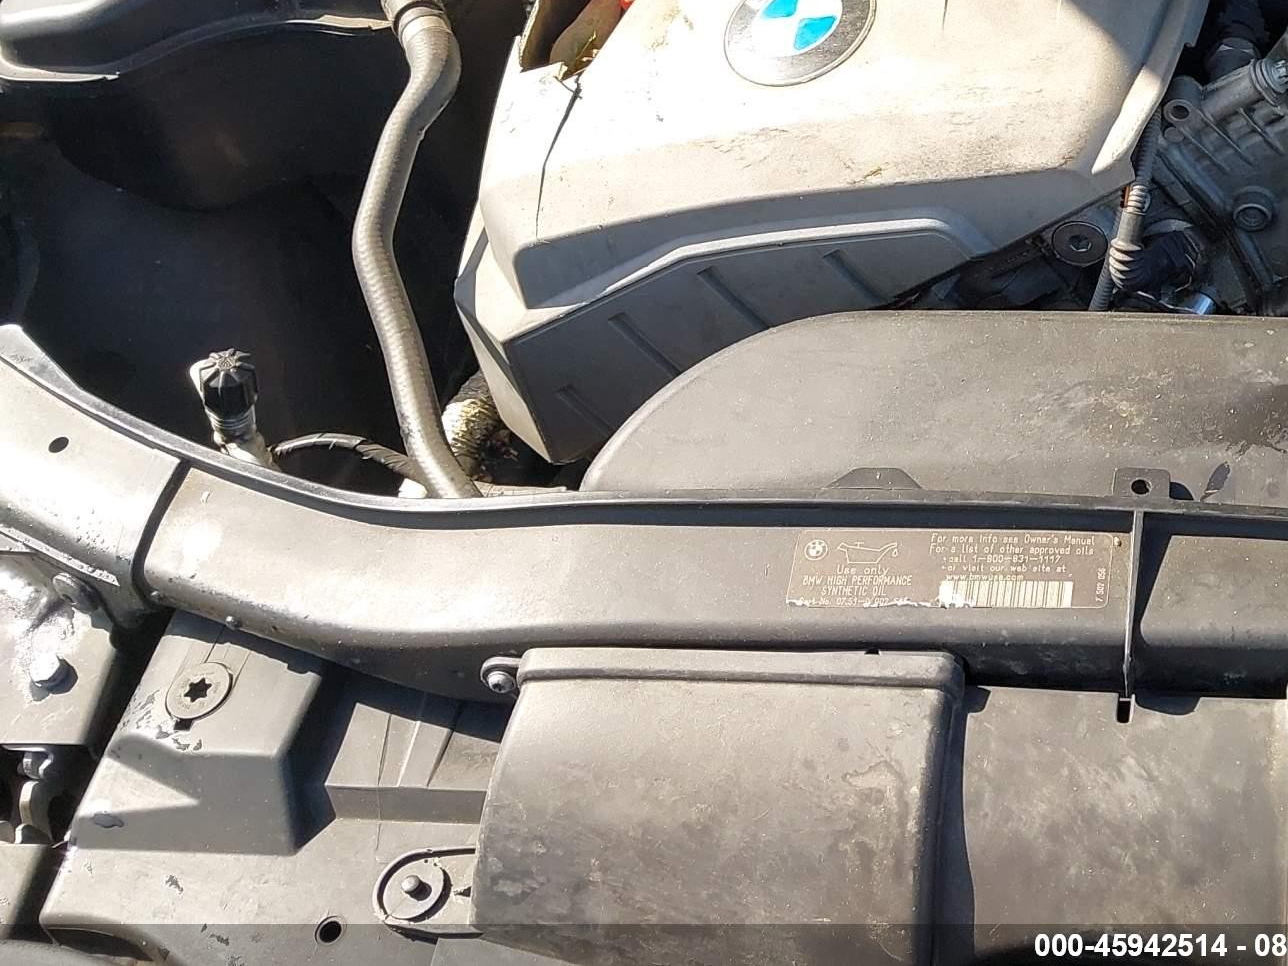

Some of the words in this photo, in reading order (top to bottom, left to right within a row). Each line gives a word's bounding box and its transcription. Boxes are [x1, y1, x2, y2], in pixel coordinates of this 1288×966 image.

[931, 533, 947, 543] For
[952, 535, 974, 543] more
[980, 533, 998, 544] info
[1024, 534, 1058, 545] Owner's
[1064, 535, 1095, 546] Manual
[929, 543, 945, 554] For
[983, 544, 994, 554] of
[999, 544, 1024, 554] other
[1029, 545, 1071, 555] approved
[863, 565, 890, 577] only
[827, 575, 848, 586] HIGH
[851, 575, 913, 586] PERFORMANCE
[821, 585, 868, 596] SYNTHETIC
[872, 585, 887, 596] OIL
